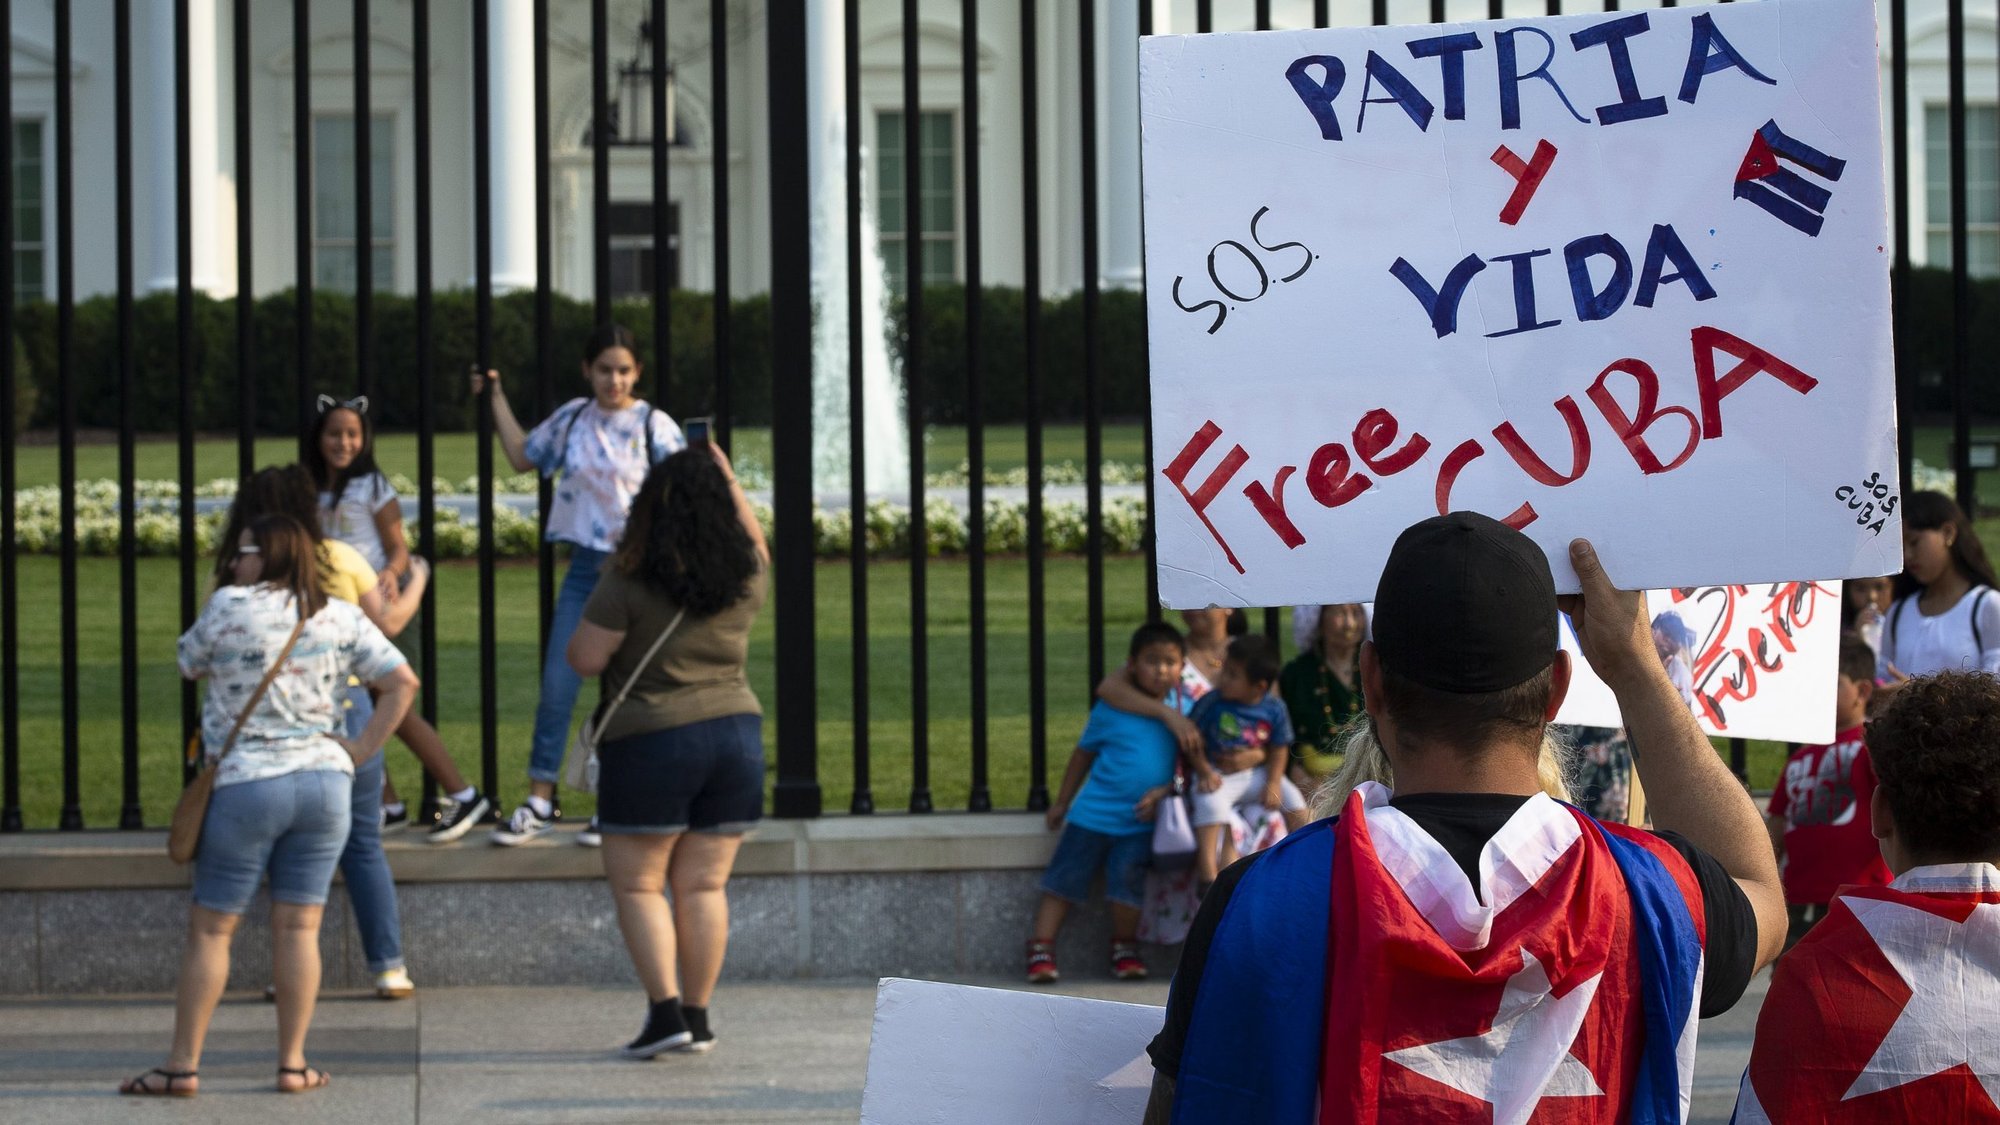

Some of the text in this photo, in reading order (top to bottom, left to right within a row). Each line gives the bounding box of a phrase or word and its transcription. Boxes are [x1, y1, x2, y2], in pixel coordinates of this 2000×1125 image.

[1285, 12, 1778, 142] PATRIA
[1490, 138, 1557, 225] Y
[1172, 205, 1320, 335] S.O.S.
[1388, 223, 1718, 340] VIDA
[1163, 326, 1818, 573] Free CUBA
[1835, 485, 1886, 537] CUBA
